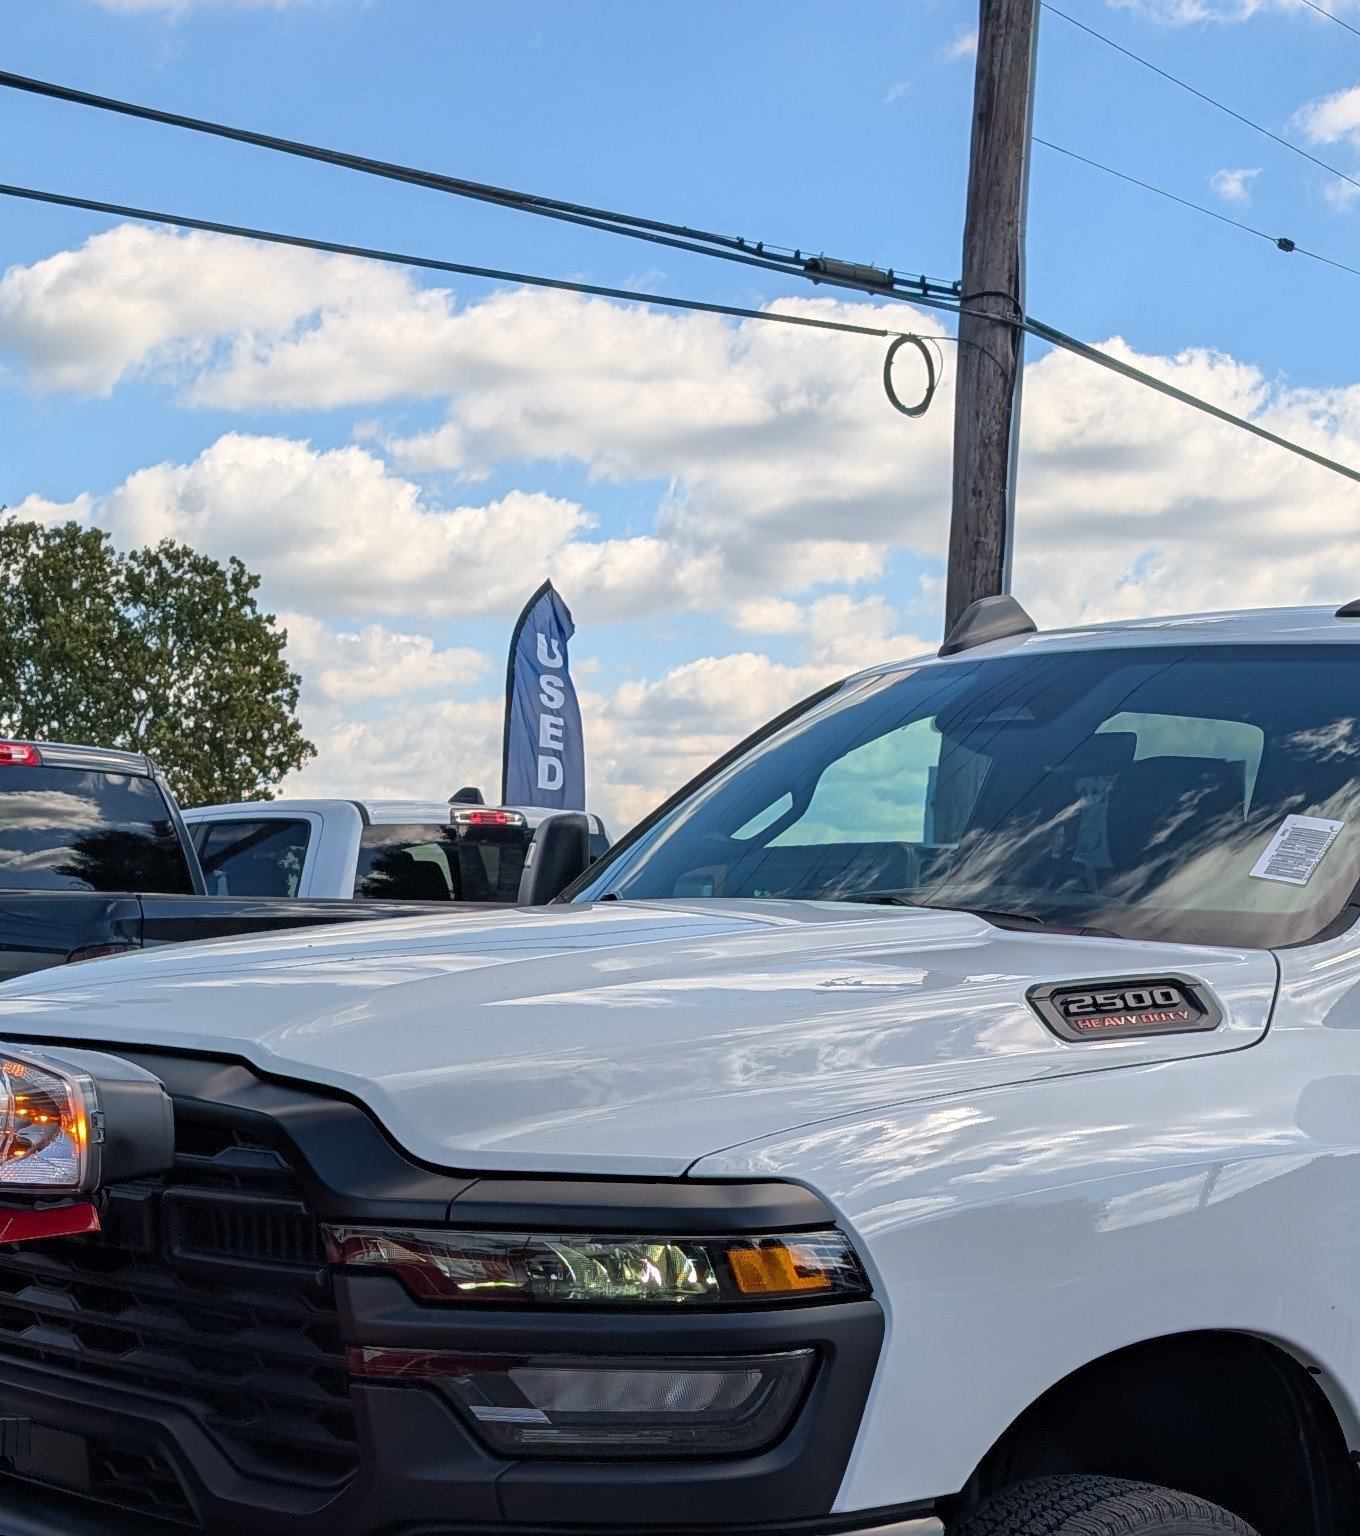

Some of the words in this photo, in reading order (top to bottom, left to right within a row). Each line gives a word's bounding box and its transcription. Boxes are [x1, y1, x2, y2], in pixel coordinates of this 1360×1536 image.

[536, 632, 565, 790] USED
[1064, 988, 1181, 1017] 2500
[1076, 1013, 1138, 1030] HEAVY
[1140, 1010, 1190, 1024] DUTY
